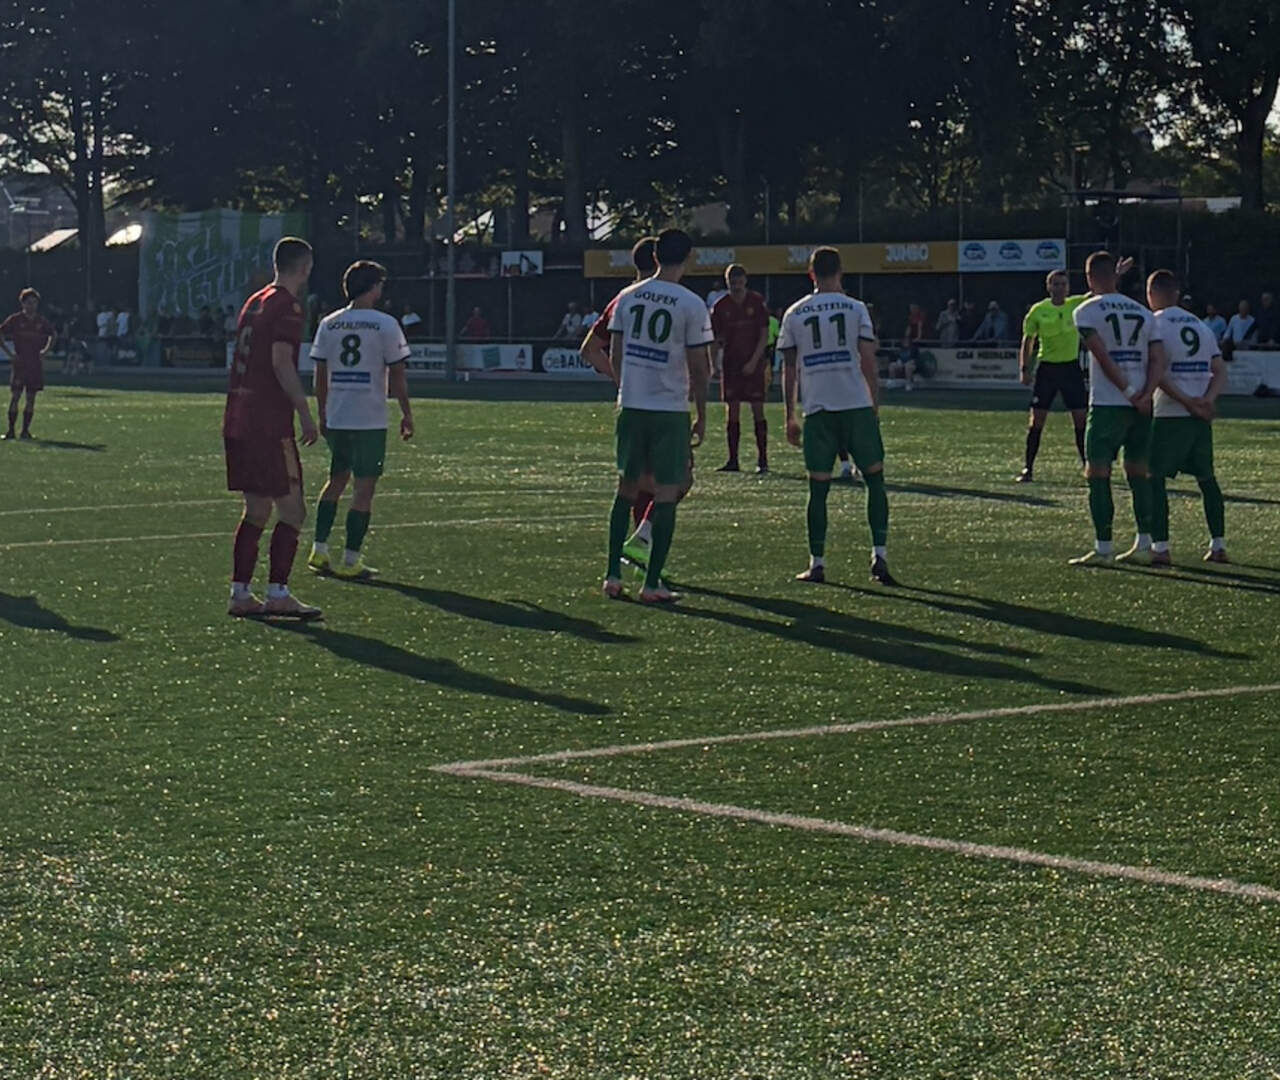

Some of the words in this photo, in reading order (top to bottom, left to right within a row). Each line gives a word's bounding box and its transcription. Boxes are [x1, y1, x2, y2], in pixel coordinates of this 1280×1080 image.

[630, 304, 672, 343] 10
[804, 313, 846, 349] 11
[1105, 313, 1145, 346] 17
[340, 334, 361, 367] 8
[1180, 326, 1200, 357] 9
